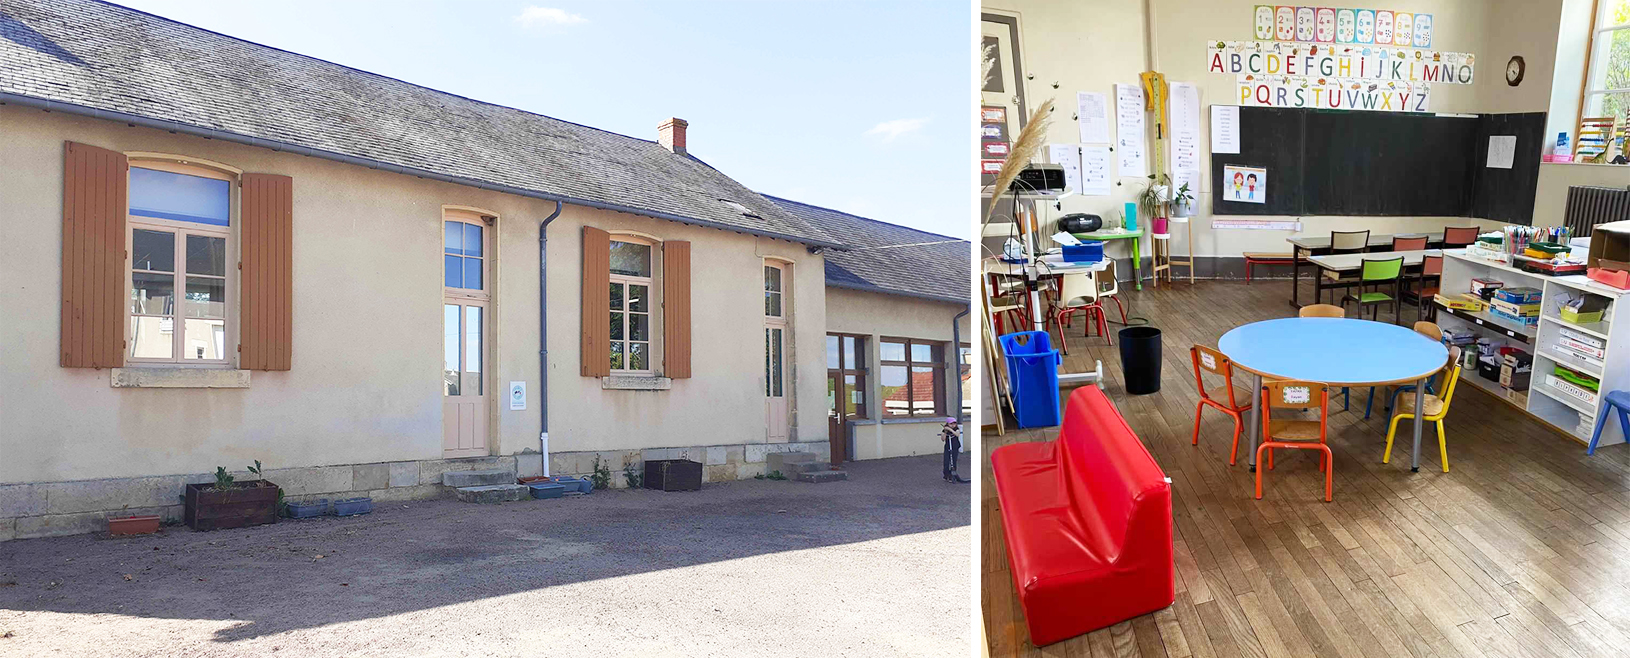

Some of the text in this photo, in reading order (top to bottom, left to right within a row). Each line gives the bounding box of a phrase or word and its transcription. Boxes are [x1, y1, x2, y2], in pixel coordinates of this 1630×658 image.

[1278, 15, 1284, 24] 2
[1299, 16, 1304, 25] 3
[1319, 17, 1324, 25] 4
[1339, 18, 1344, 26] 5
[1359, 18, 1363, 27] 6
[1378, 19, 1383, 27] 7
[1398, 21, 1402, 30] 8
[1417, 23, 1421, 31] 9
[1210, 53, 1224, 73] A
[1231, 53, 1242, 73] B
[1249, 53, 1261, 73] C
[1267, 54, 1280, 74] D
[1286, 55, 1296, 74] E
[1305, 56, 1314, 75] F
[1320, 57, 1333, 76] G
[1338, 57, 1351, 77] H
[1375, 60, 1383, 78] J
[1391, 60, 1402, 80] K
[1409, 62, 1418, 81] L
[1423, 64, 1439, 82] M
[1441, 63, 1454, 82] N
[1458, 65, 1472, 83] O
[1241, 84, 1426, 112] P Q R S T U V W X Y Z
